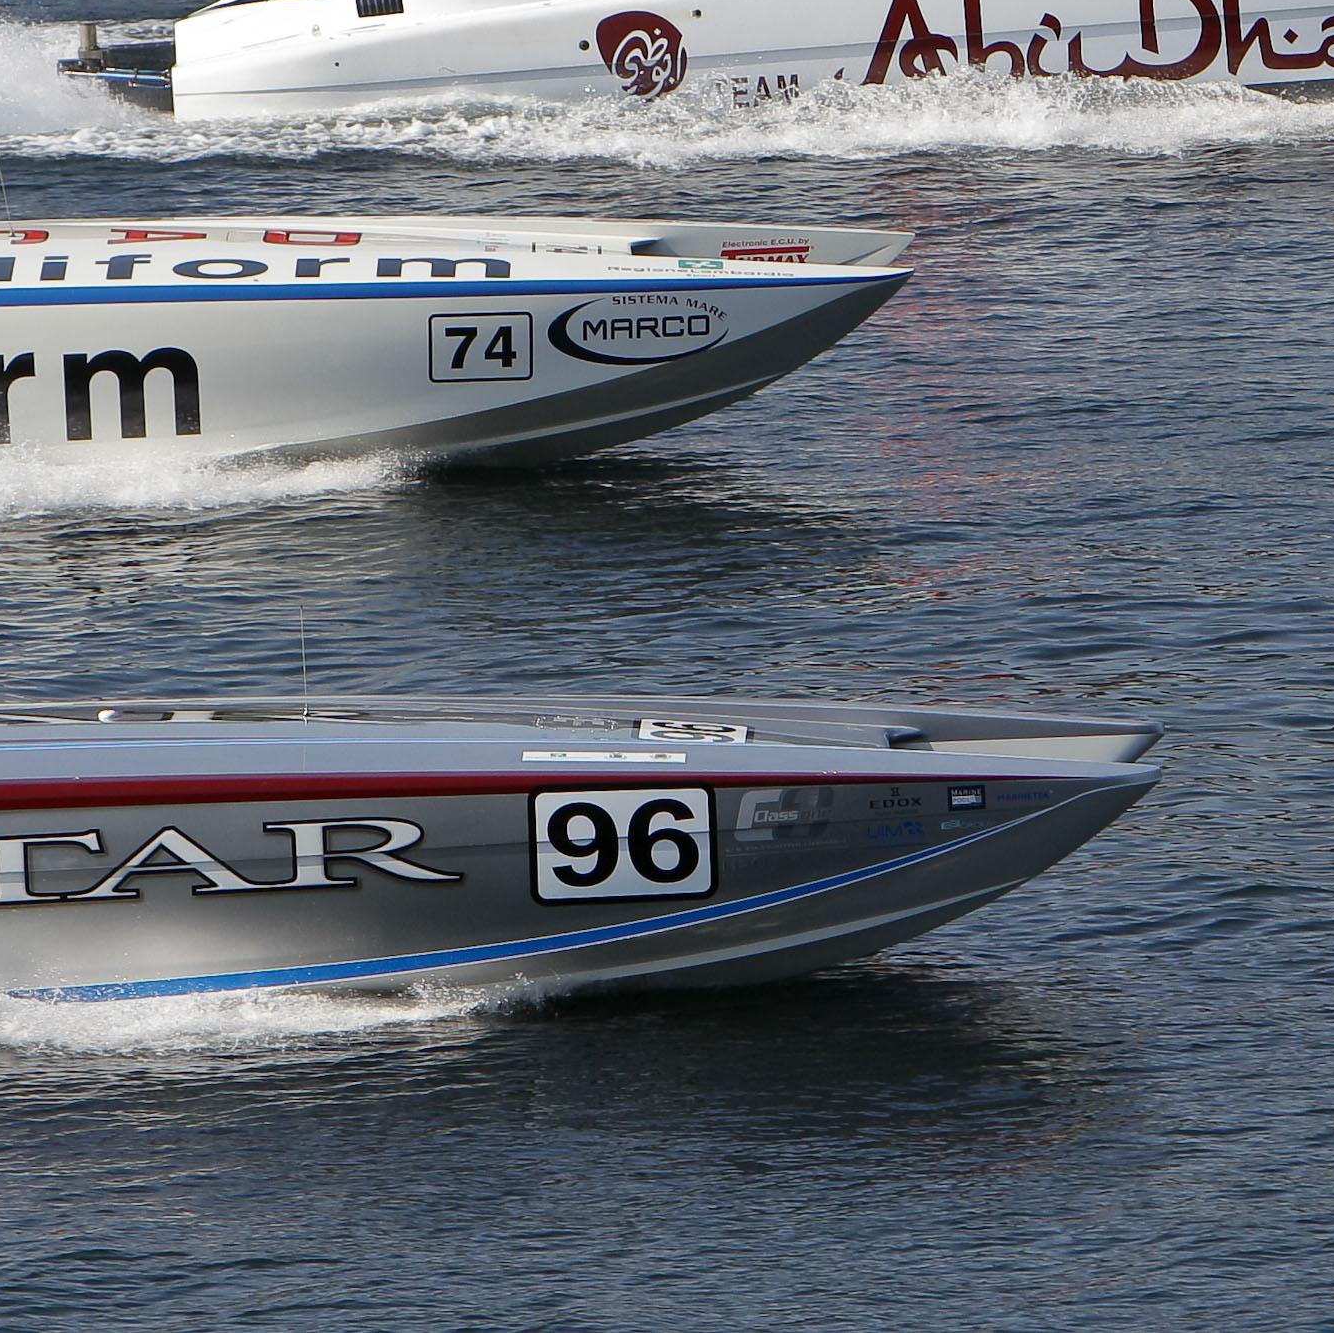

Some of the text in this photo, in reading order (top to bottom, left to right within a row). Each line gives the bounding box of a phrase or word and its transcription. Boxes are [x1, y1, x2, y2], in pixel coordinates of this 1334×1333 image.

[731, 73, 801, 109] EAM
[798, 237, 810, 246] by
[612, 295, 728, 322] SISTEMA MARE
[582, 314, 710, 341] MARCO
[444, 325, 517, 369] 74
[754, 809, 800, 823] Class
[869, 796, 922, 809] EDOX
[546, 798, 701, 888] 96
